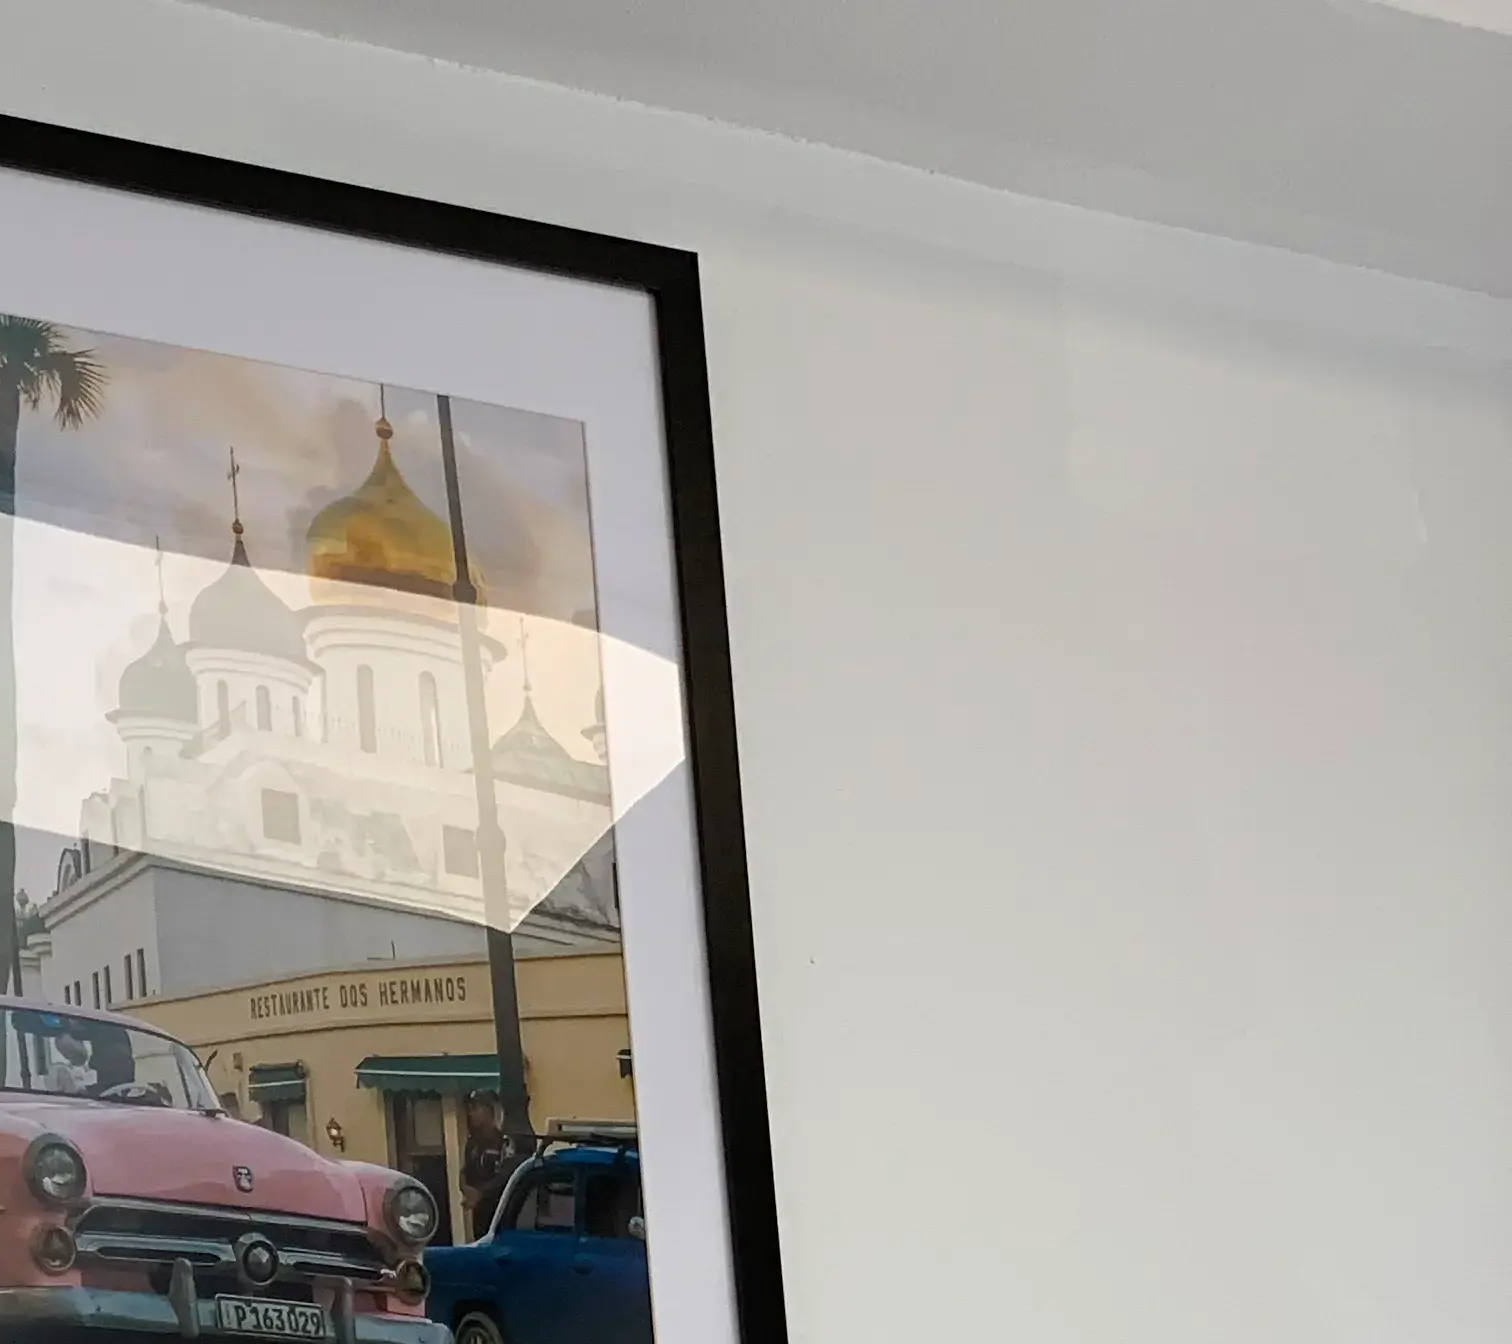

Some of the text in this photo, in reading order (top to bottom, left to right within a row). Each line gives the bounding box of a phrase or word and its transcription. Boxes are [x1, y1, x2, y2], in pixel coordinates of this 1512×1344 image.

[249, 976, 467, 1020] RESTAURANTE DOS HERMANOS
